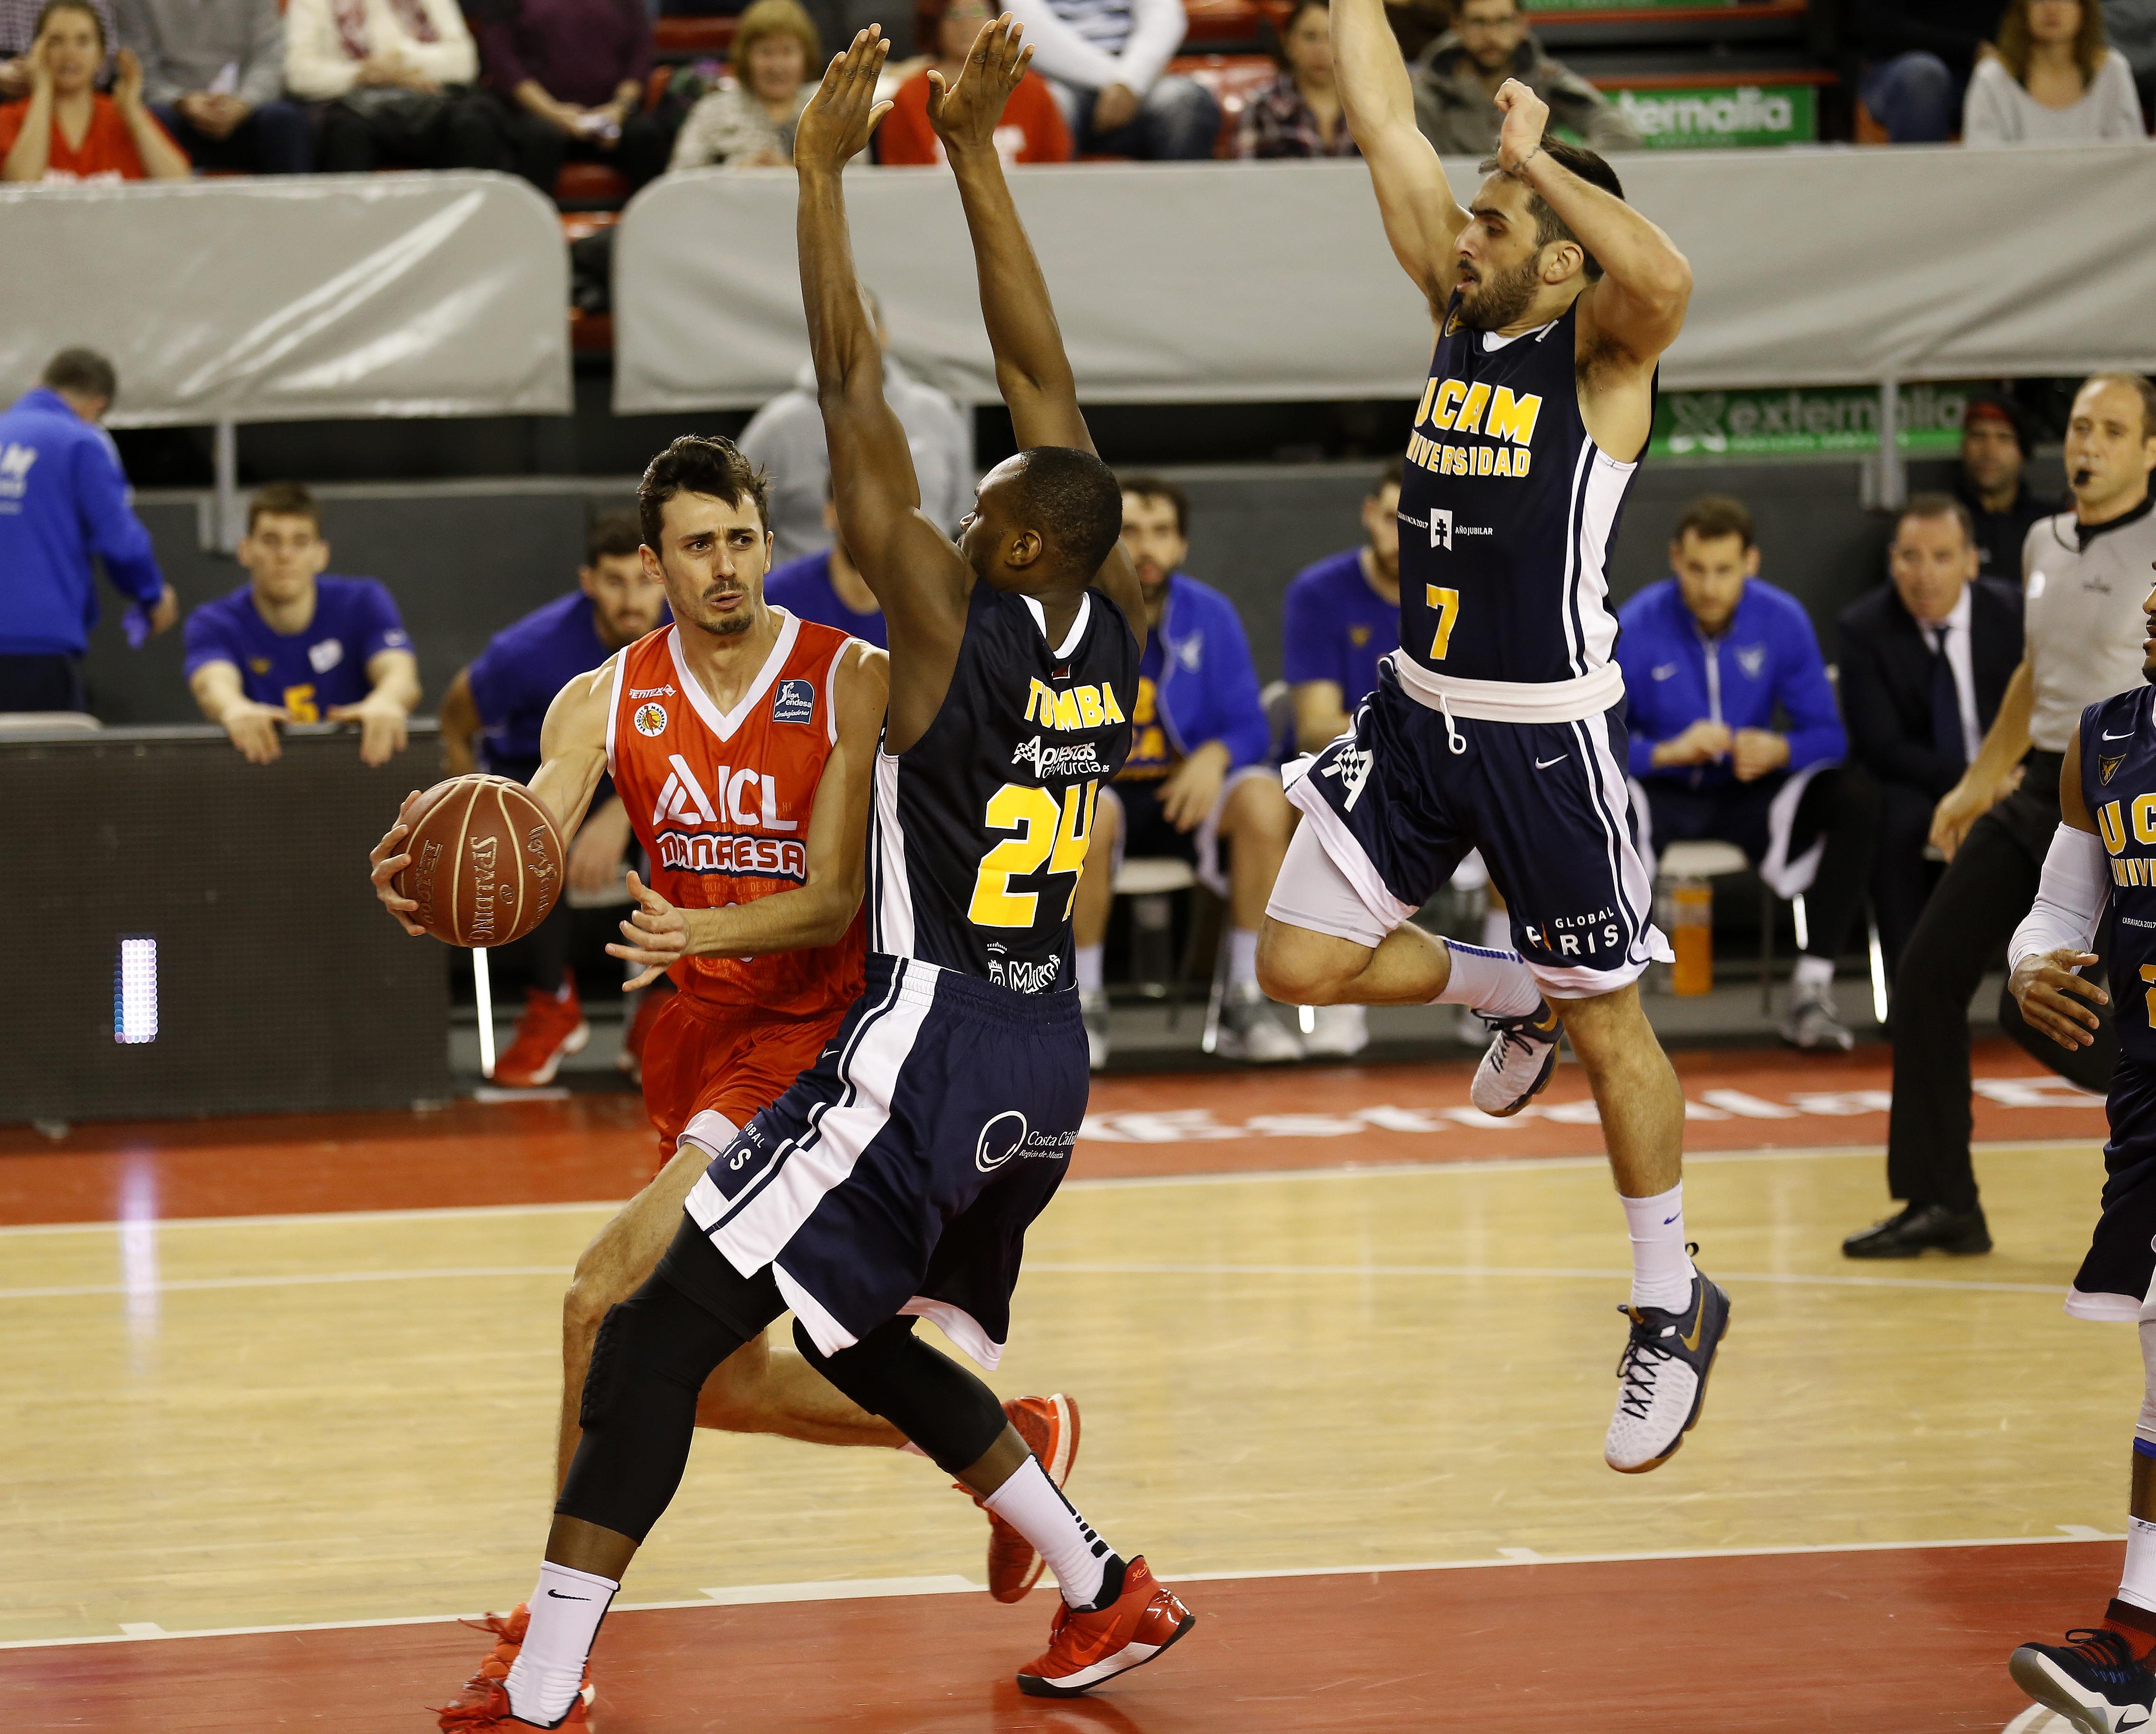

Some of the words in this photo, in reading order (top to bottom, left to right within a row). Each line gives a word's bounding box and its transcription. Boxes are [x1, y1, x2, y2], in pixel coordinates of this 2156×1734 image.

[1414, 376, 1543, 447] UCAM
[1426, 583, 1459, 660] 7
[785, 699, 811, 708] endesa
[787, 689, 799, 700] liga
[1024, 675, 1125, 732] TUMBA
[656, 832, 807, 879] MANRESA
[967, 779, 1098, 928] 24
[468, 835, 498, 941] SPALDING
[1555, 906, 1614, 928] GLOBAL
[1027, 1131, 1057, 1146] Costa
